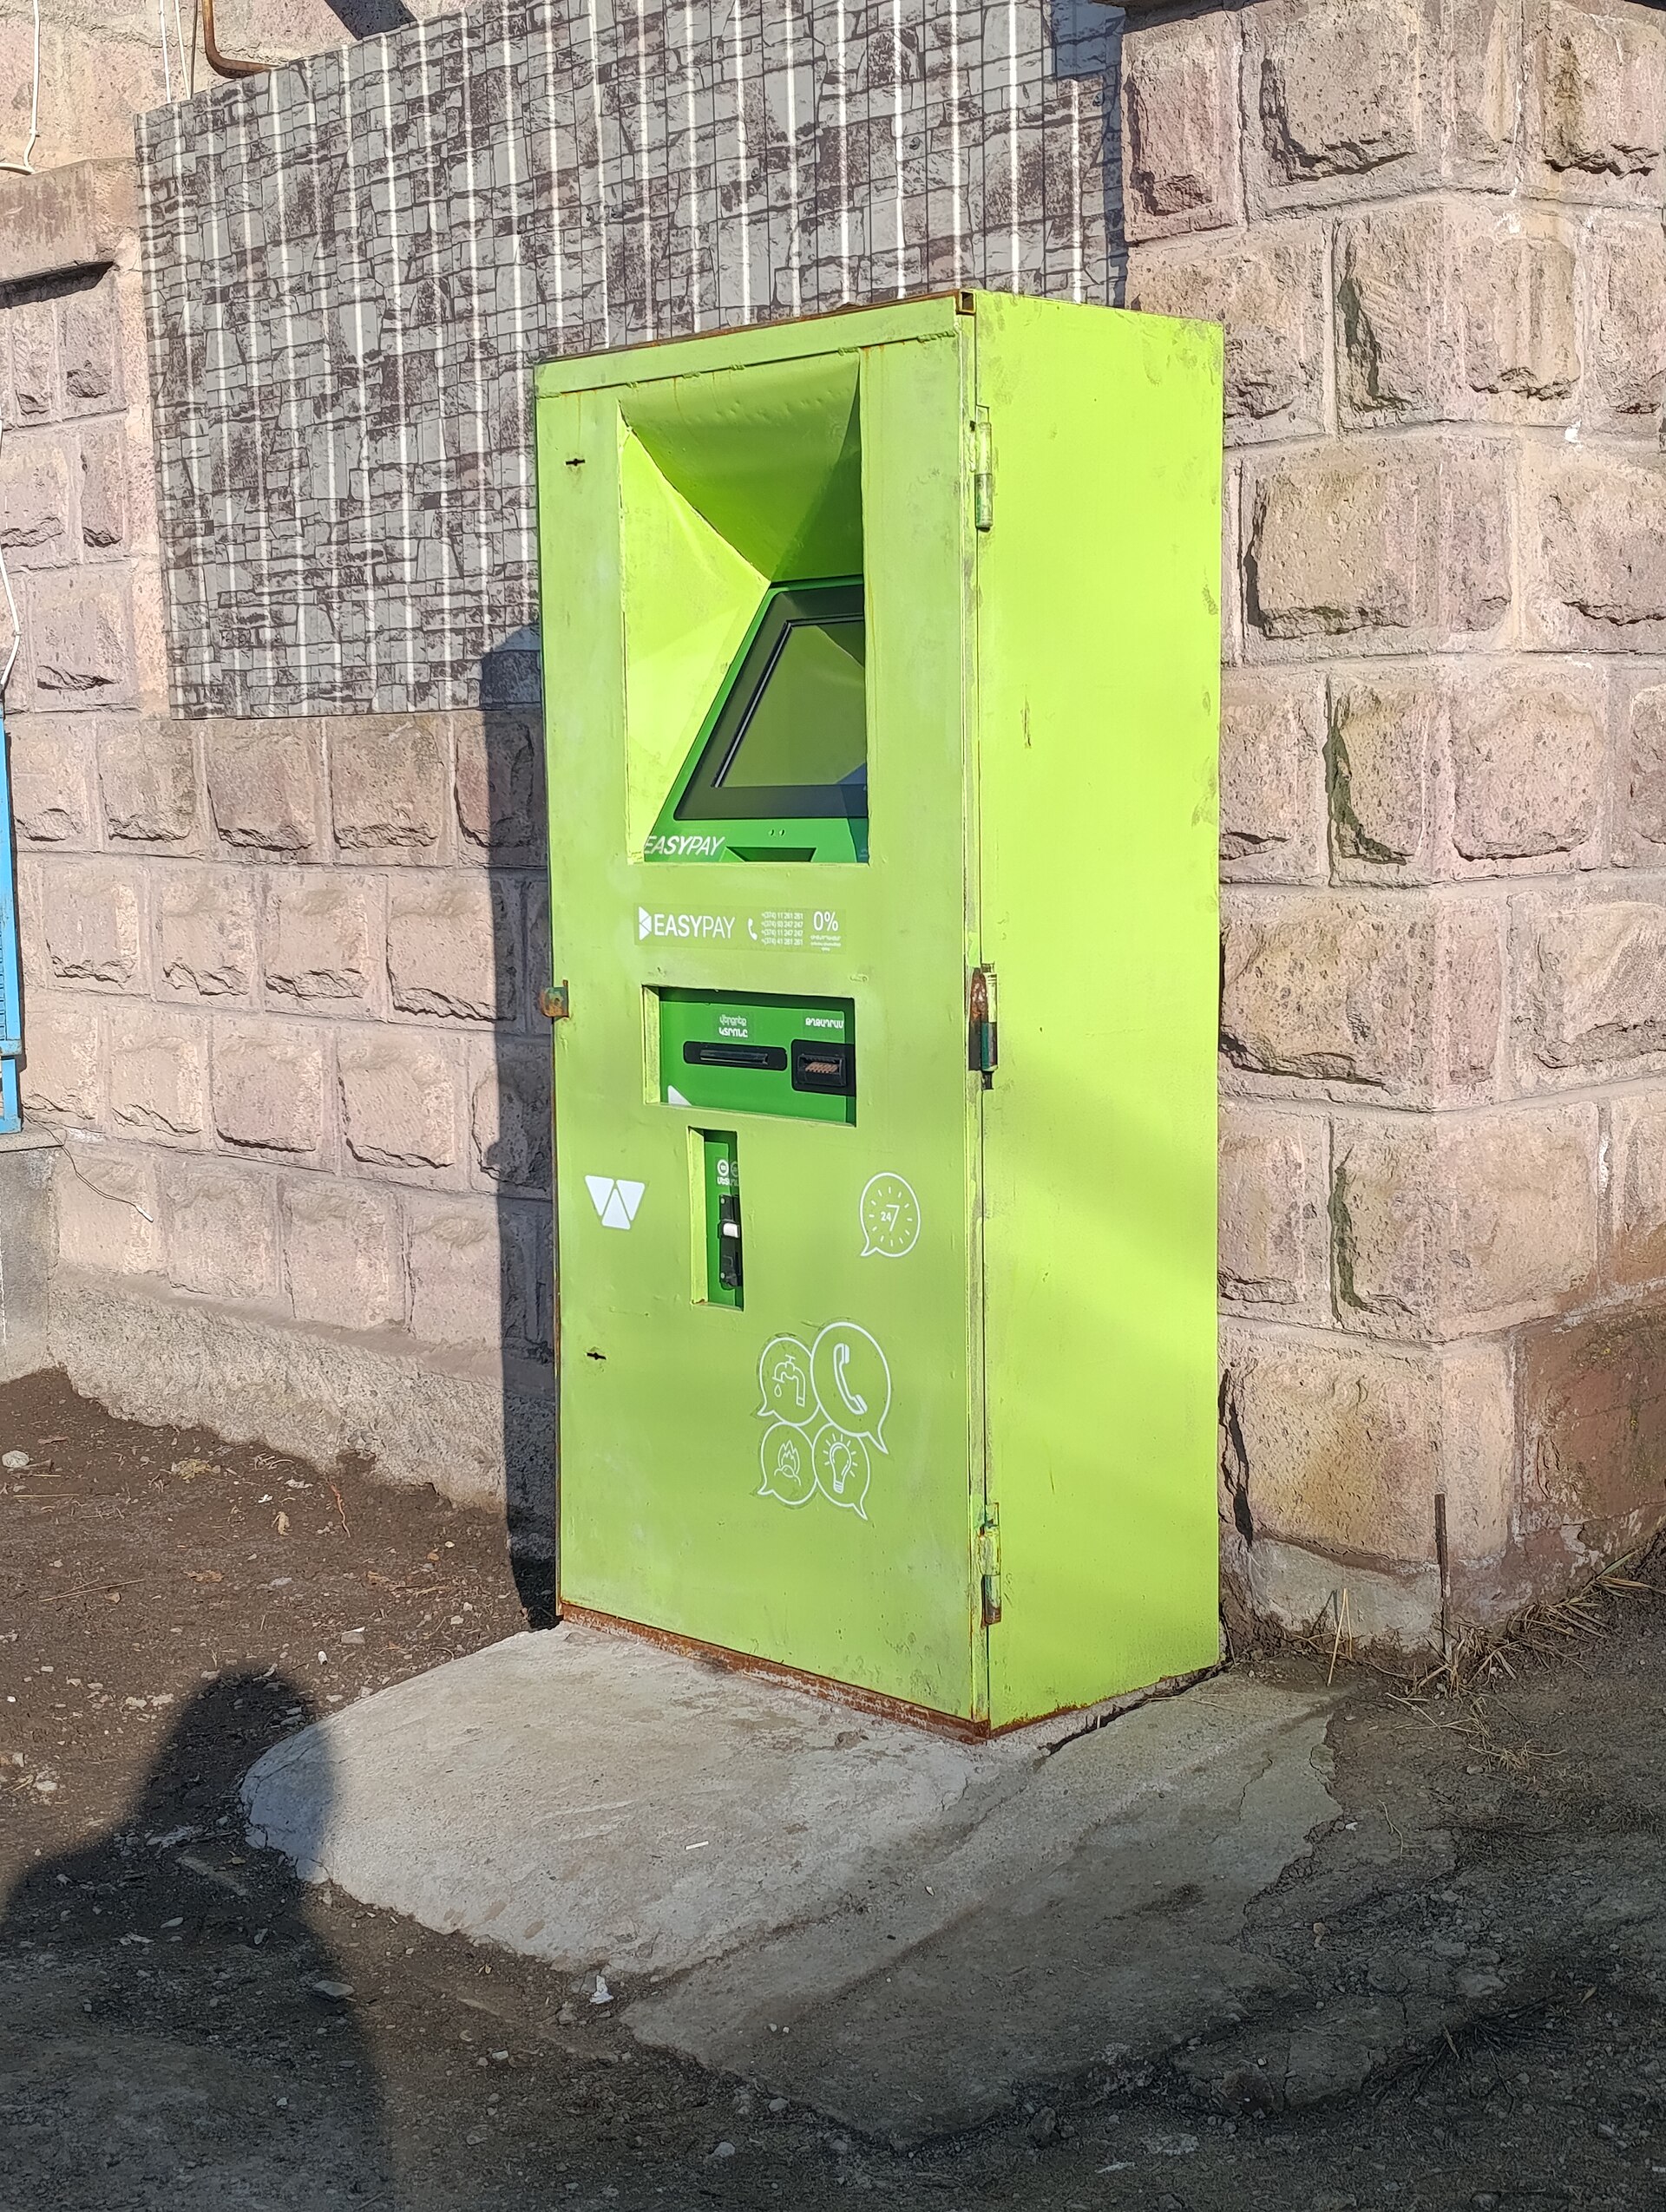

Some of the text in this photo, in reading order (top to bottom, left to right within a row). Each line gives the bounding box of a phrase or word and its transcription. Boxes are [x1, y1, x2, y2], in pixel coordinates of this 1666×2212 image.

[643, 835, 725, 856] EASYPAY
[654, 913, 735, 939] EASYPAY
[813, 911, 838, 932] 0%
